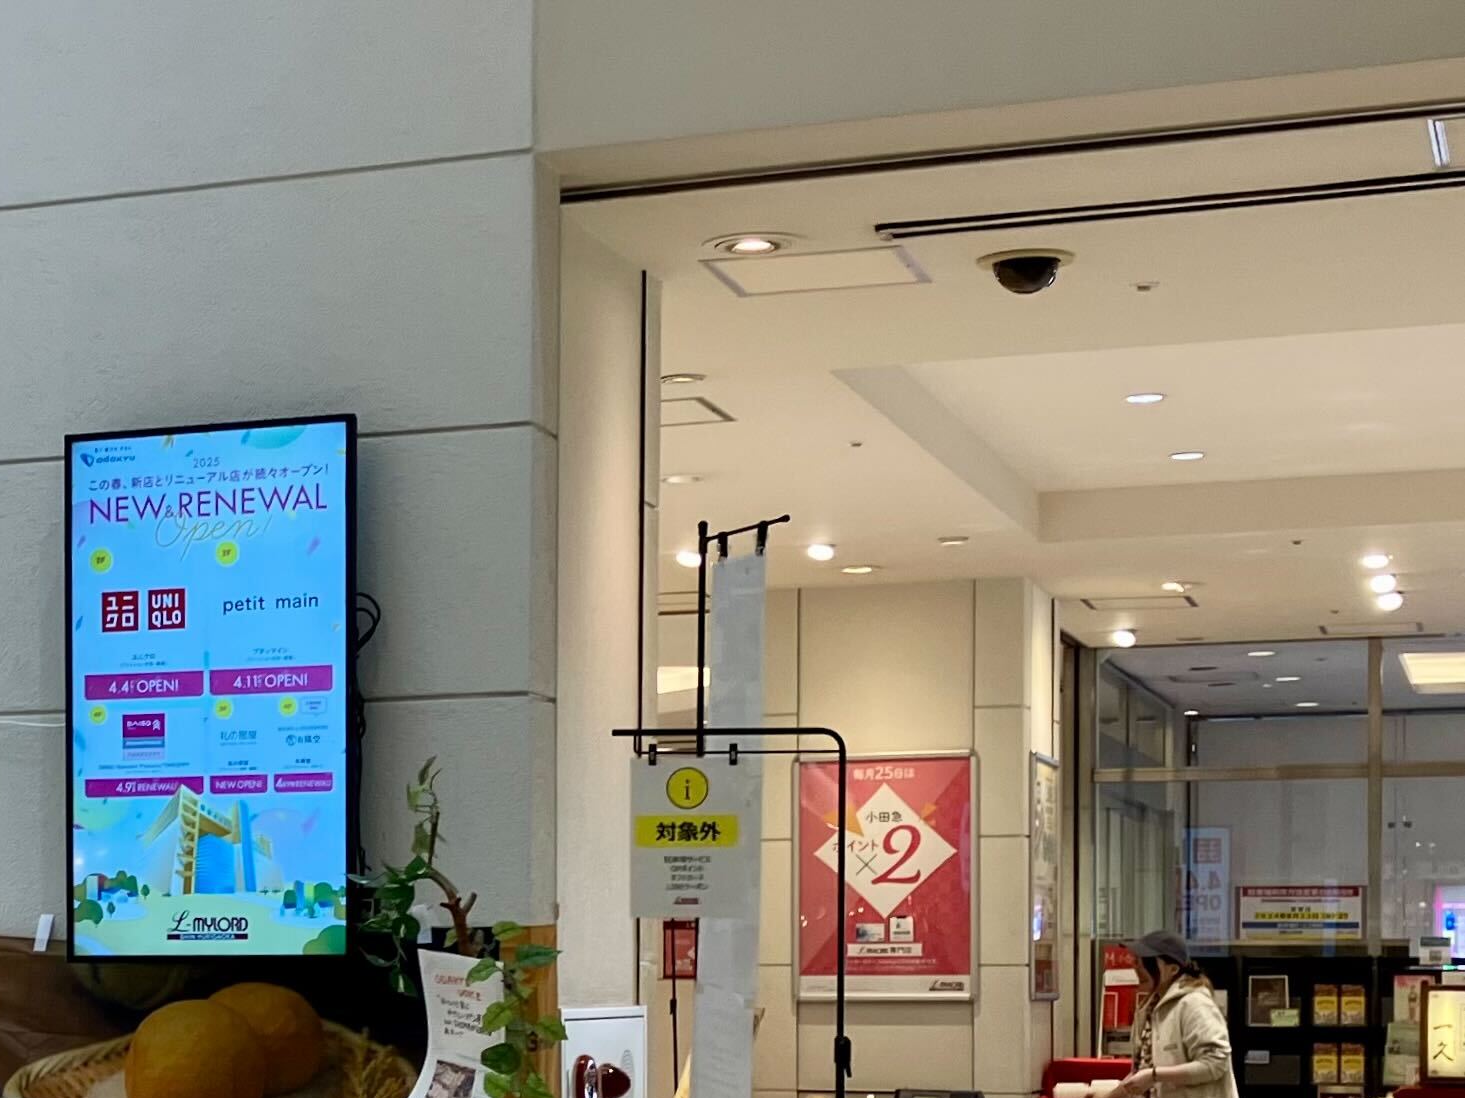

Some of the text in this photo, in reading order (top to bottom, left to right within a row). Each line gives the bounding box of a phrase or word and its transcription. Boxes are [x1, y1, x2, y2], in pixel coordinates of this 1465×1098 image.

[193, 457, 220, 469] 2025
[223, 594, 319, 615] petit main
[865, 811, 903, 823] 小田急
[656, 821, 721, 843] 対象外
